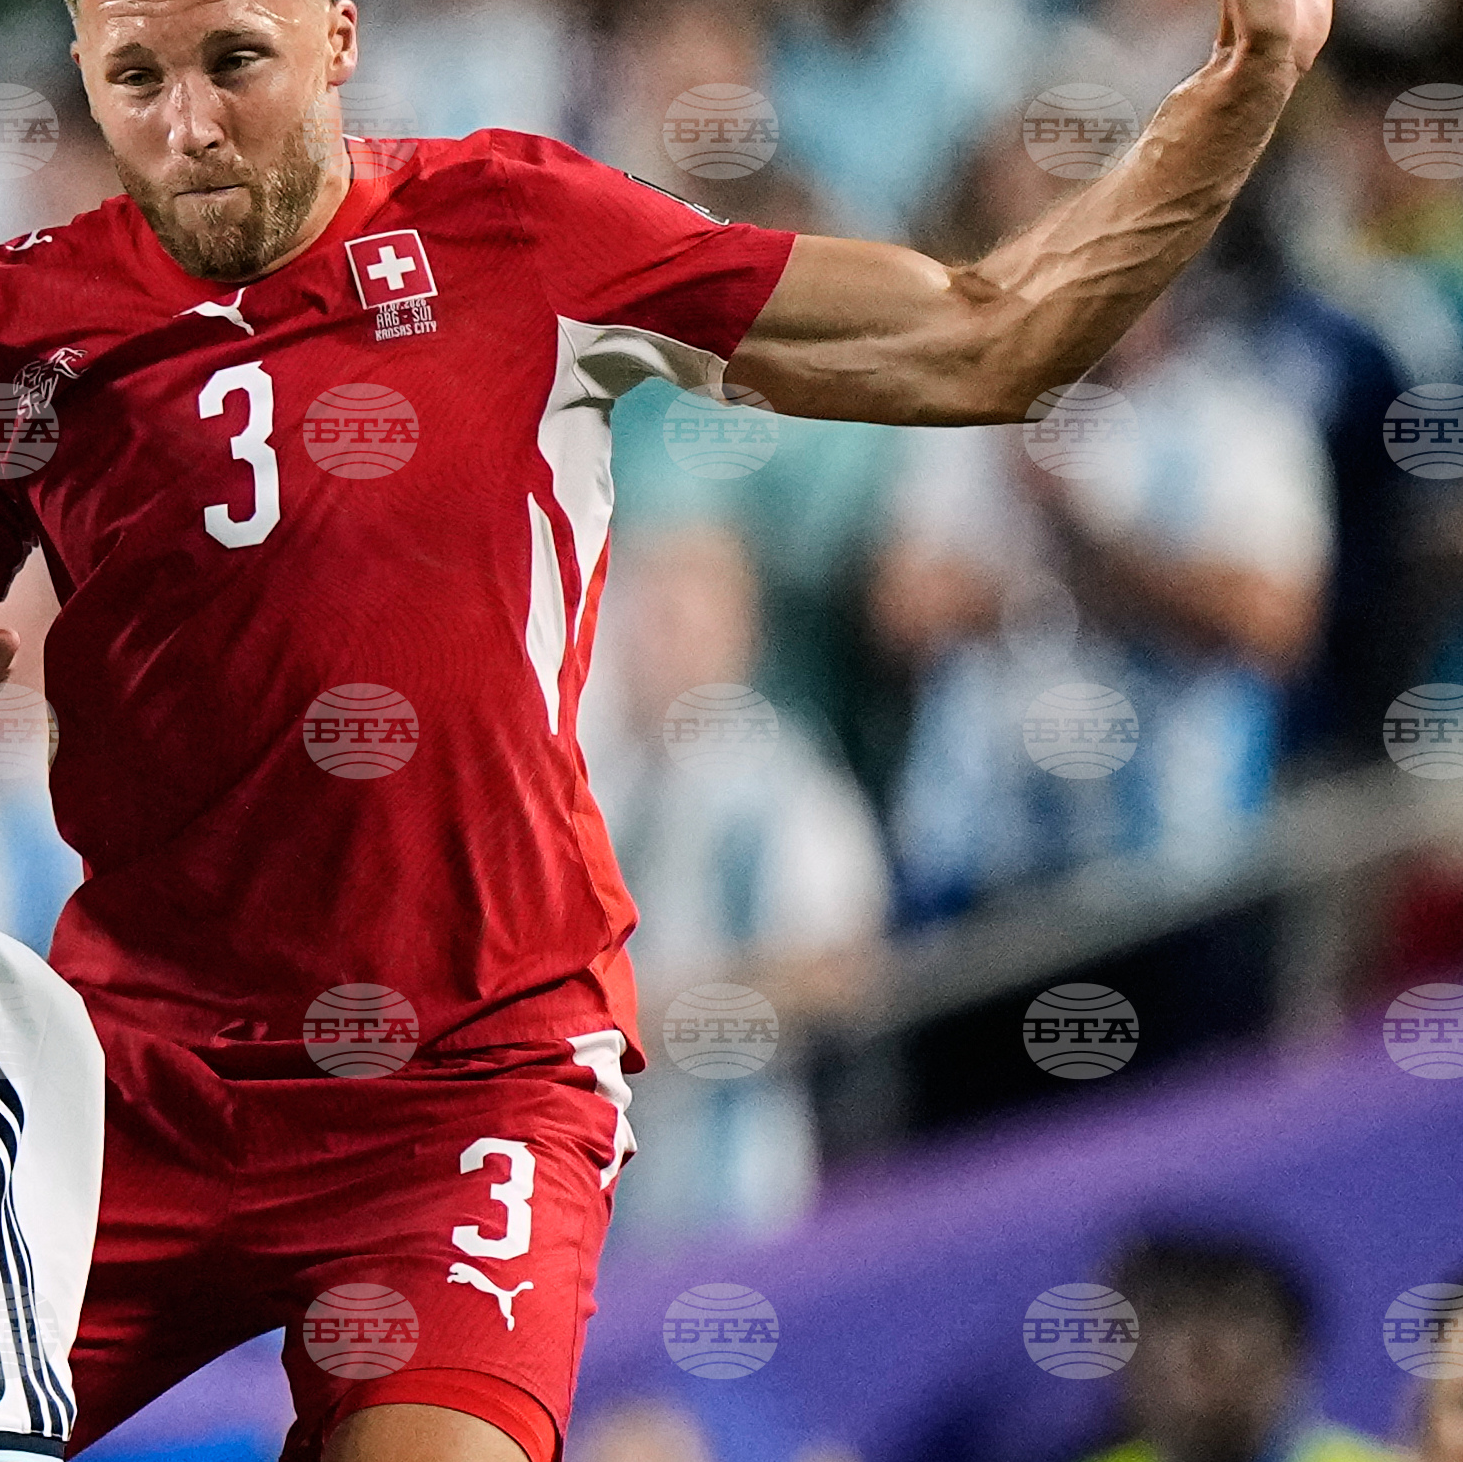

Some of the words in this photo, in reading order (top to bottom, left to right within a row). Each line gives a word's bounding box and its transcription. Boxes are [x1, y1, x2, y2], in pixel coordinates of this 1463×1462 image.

[375, 324, 413, 341] KANSAS
[414, 321, 437, 334] CITY
[376, 311, 400, 329] ARG
[412, 305, 432, 322] SUI
[197, 360, 280, 549] 3
[452, 1137, 534, 1260] 3
